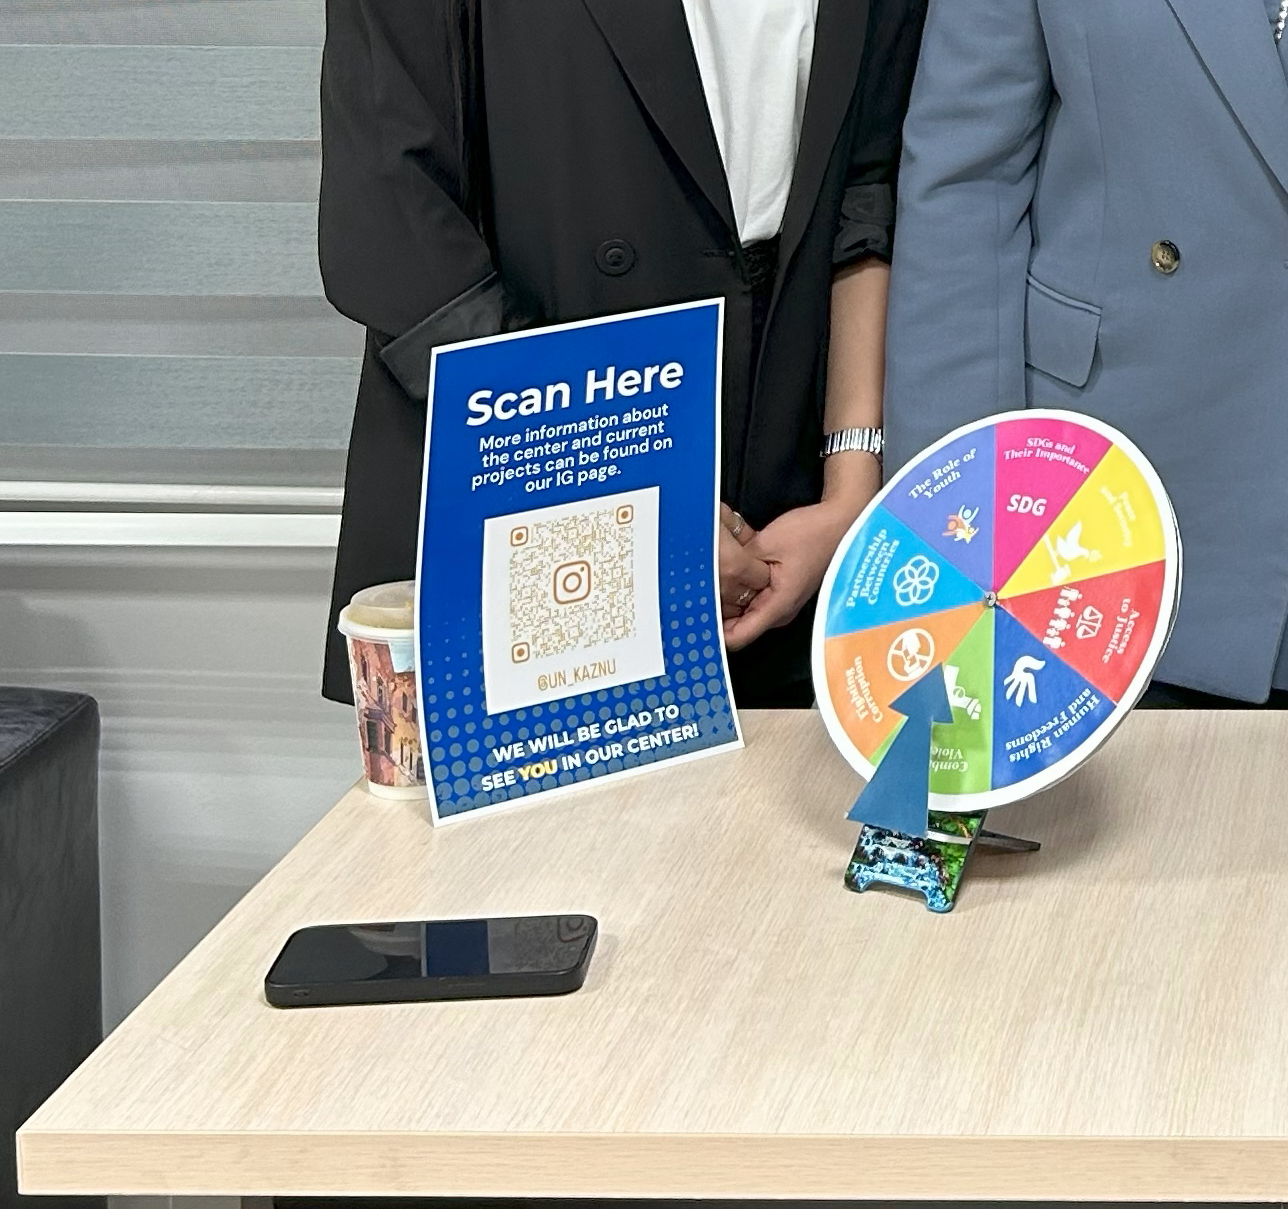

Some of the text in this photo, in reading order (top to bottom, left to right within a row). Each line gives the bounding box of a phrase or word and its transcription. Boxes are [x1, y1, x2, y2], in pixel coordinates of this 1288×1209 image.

[466, 361, 684, 426] Scan Here
[479, 403, 669, 453] More information about
[482, 420, 665, 468] the center and current
[1026, 437, 1076, 454] SDGs and
[471, 436, 673, 491] projects can be found on
[525, 463, 622, 492] our IG page.
[908, 448, 977, 500] The Role of
[924, 471, 961, 499] Youth
[1004, 448, 1091, 475] Their Importance
[1007, 494, 1048, 517] SDG
[846, 528, 888, 608] Partnership
[860, 541, 890, 598] Between
[868, 539, 900, 605] Countries
[1101, 598, 1132, 664] to Justice
[1117, 607, 1140, 655] Access
[537, 659, 617, 691] @UN_KAZNU
[845, 667, 869, 721] Fighting
[854, 656, 884, 724] Corruption
[492, 704, 680, 763] WE WILL BE GLAD TO
[1005, 688, 1092, 751] and Freedoms
[1009, 694, 1101, 763] Human Rights
[481, 723, 700, 792] SEE YOU IN OUR CENTER!
